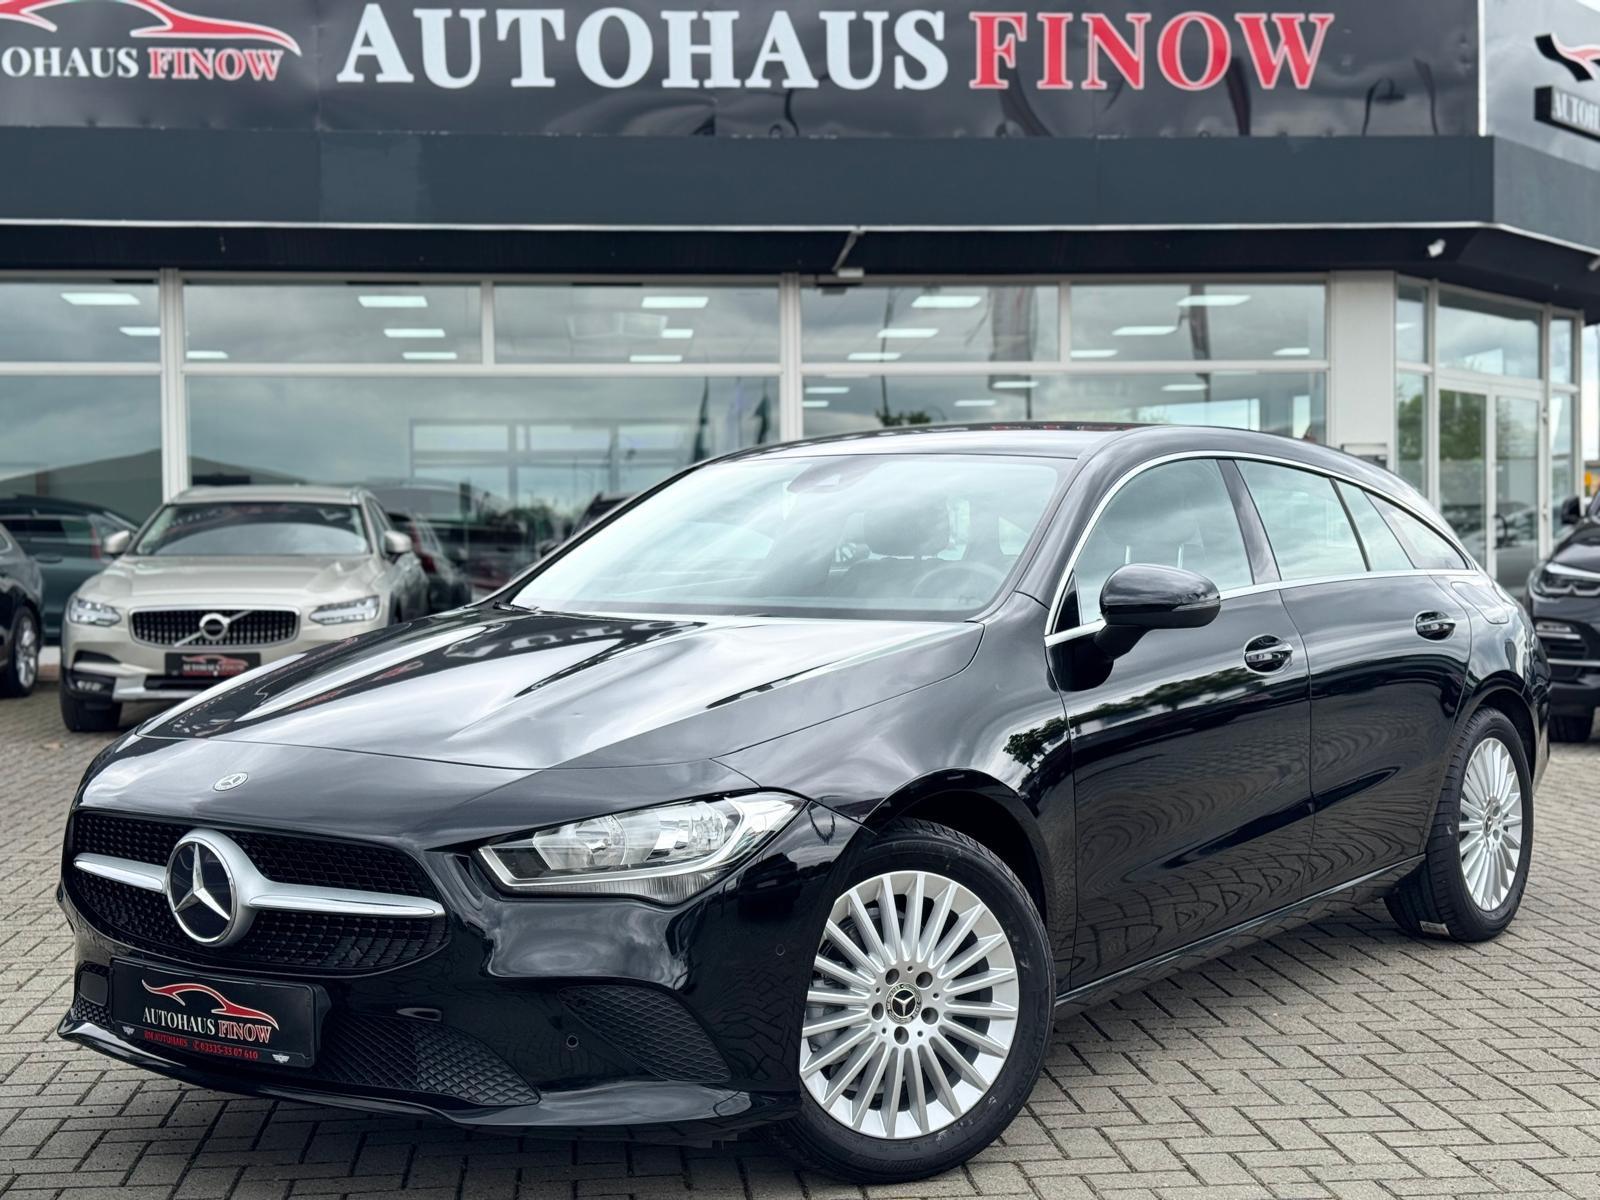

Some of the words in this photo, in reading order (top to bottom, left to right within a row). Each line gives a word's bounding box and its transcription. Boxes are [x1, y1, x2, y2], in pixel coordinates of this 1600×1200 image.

[1, 47, 140, 79] OHAUS
[147, 47, 284, 81] FINOW
[337, 3, 949, 91] AUTOHAUS
[968, 11, 1335, 90] FINOW
[142, 1006, 216, 1036] AUTOHAUS
[217, 1019, 272, 1044] FINOW
